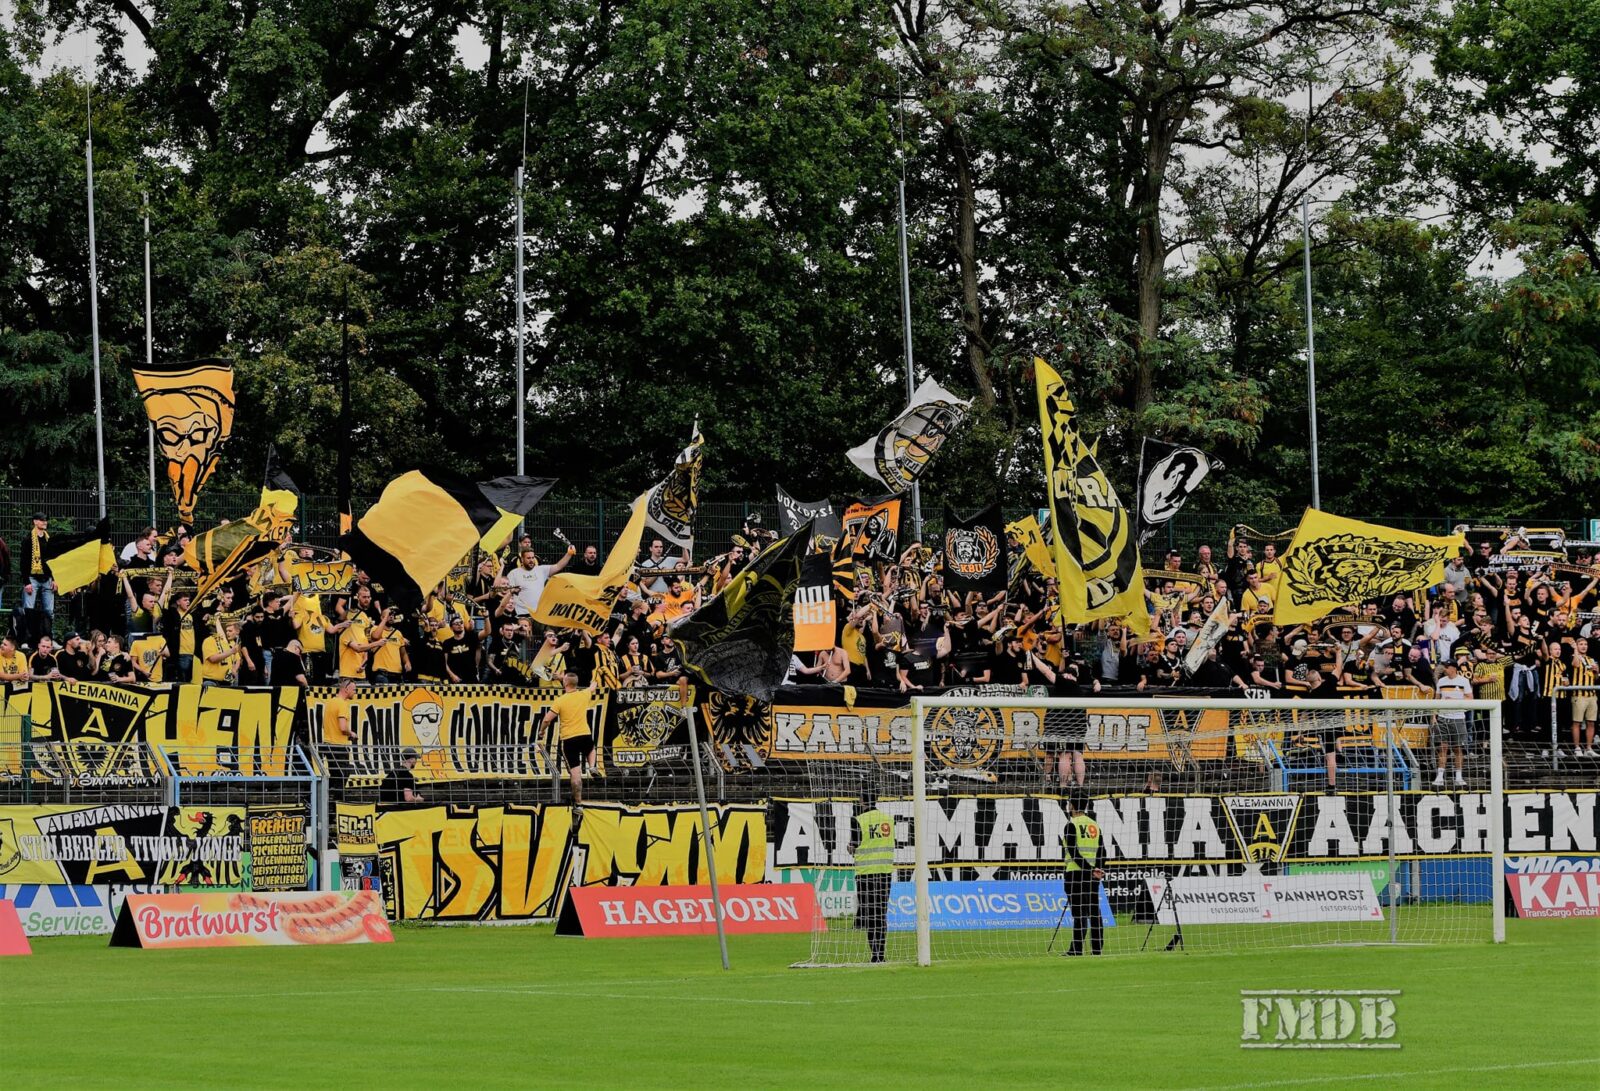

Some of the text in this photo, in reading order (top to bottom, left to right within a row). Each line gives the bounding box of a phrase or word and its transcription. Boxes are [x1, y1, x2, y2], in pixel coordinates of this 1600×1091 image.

[959, 563, 984, 574] KBU
[59, 682, 139, 708] ALEMANNIA
[647, 690, 692, 703] STAD
[617, 751, 646, 763] UND
[1230, 798, 1294, 808] ALEMANNIA
[47, 805, 160, 833] ALEMANNIA
[1308, 792, 1598, 856] AACHEN
[869, 822, 891, 839] K9
[1079, 824, 1099, 839] K9
[19, 835, 128, 861] STOLBERGER
[130, 835, 187, 861] TIVOLI
[252, 844, 304, 857] SICHERHEIT
[253, 856, 263, 866] ZU
[375, 805, 573, 918] TSV
[253, 874, 305, 886] ZU VERLIEREN
[1010, 868, 1166, 882] Motoren rsatzteile
[898, 887, 1022, 914] eronics
[1274, 890, 1365, 902] PANNHORST
[599, 896, 799, 925] HAGEDORN
[1210, 906, 1260, 914] ENTSORGUNG
[1320, 904, 1369, 912] ENTSORGUNG
[1524, 908, 1598, 918] TransCargo GmbH
[138, 901, 280, 939] Bratwurst
